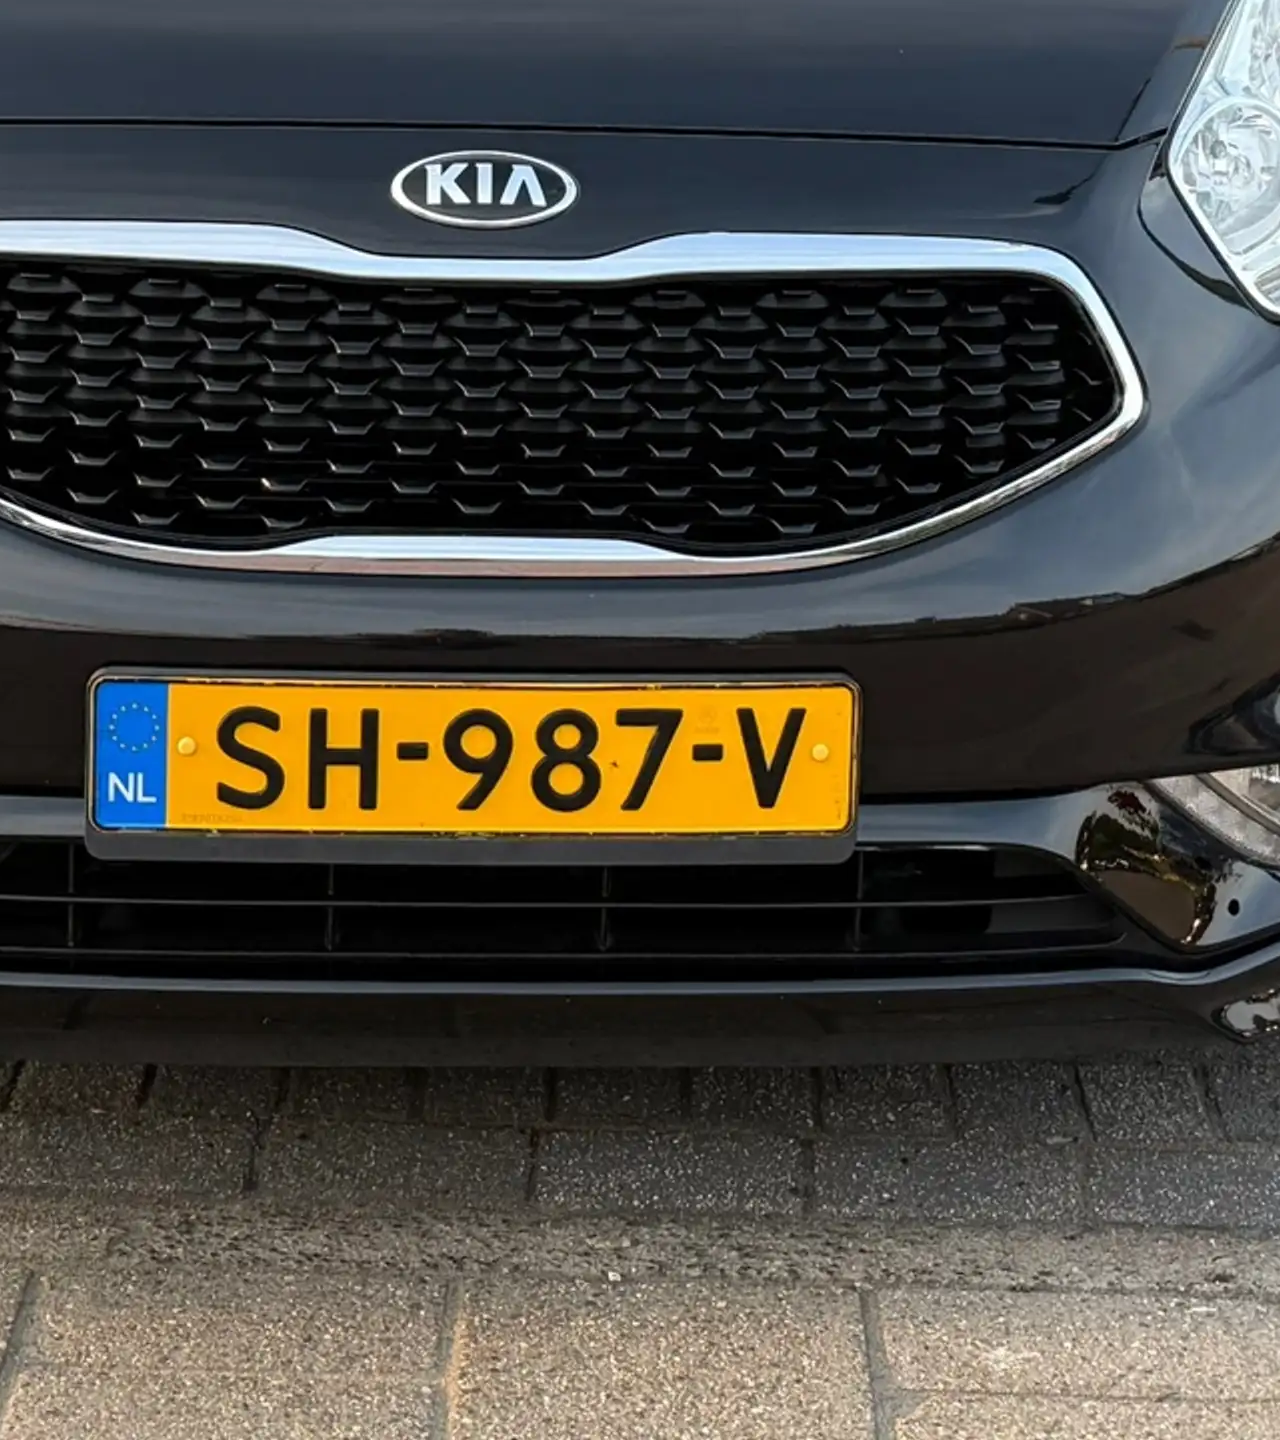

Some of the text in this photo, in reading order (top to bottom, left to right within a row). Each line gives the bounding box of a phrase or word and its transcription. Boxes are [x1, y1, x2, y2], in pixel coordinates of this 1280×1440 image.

[424, 162, 548, 207] KIA
[216, 705, 807, 813] SH-987-V
[108, 772, 157, 803] NL
